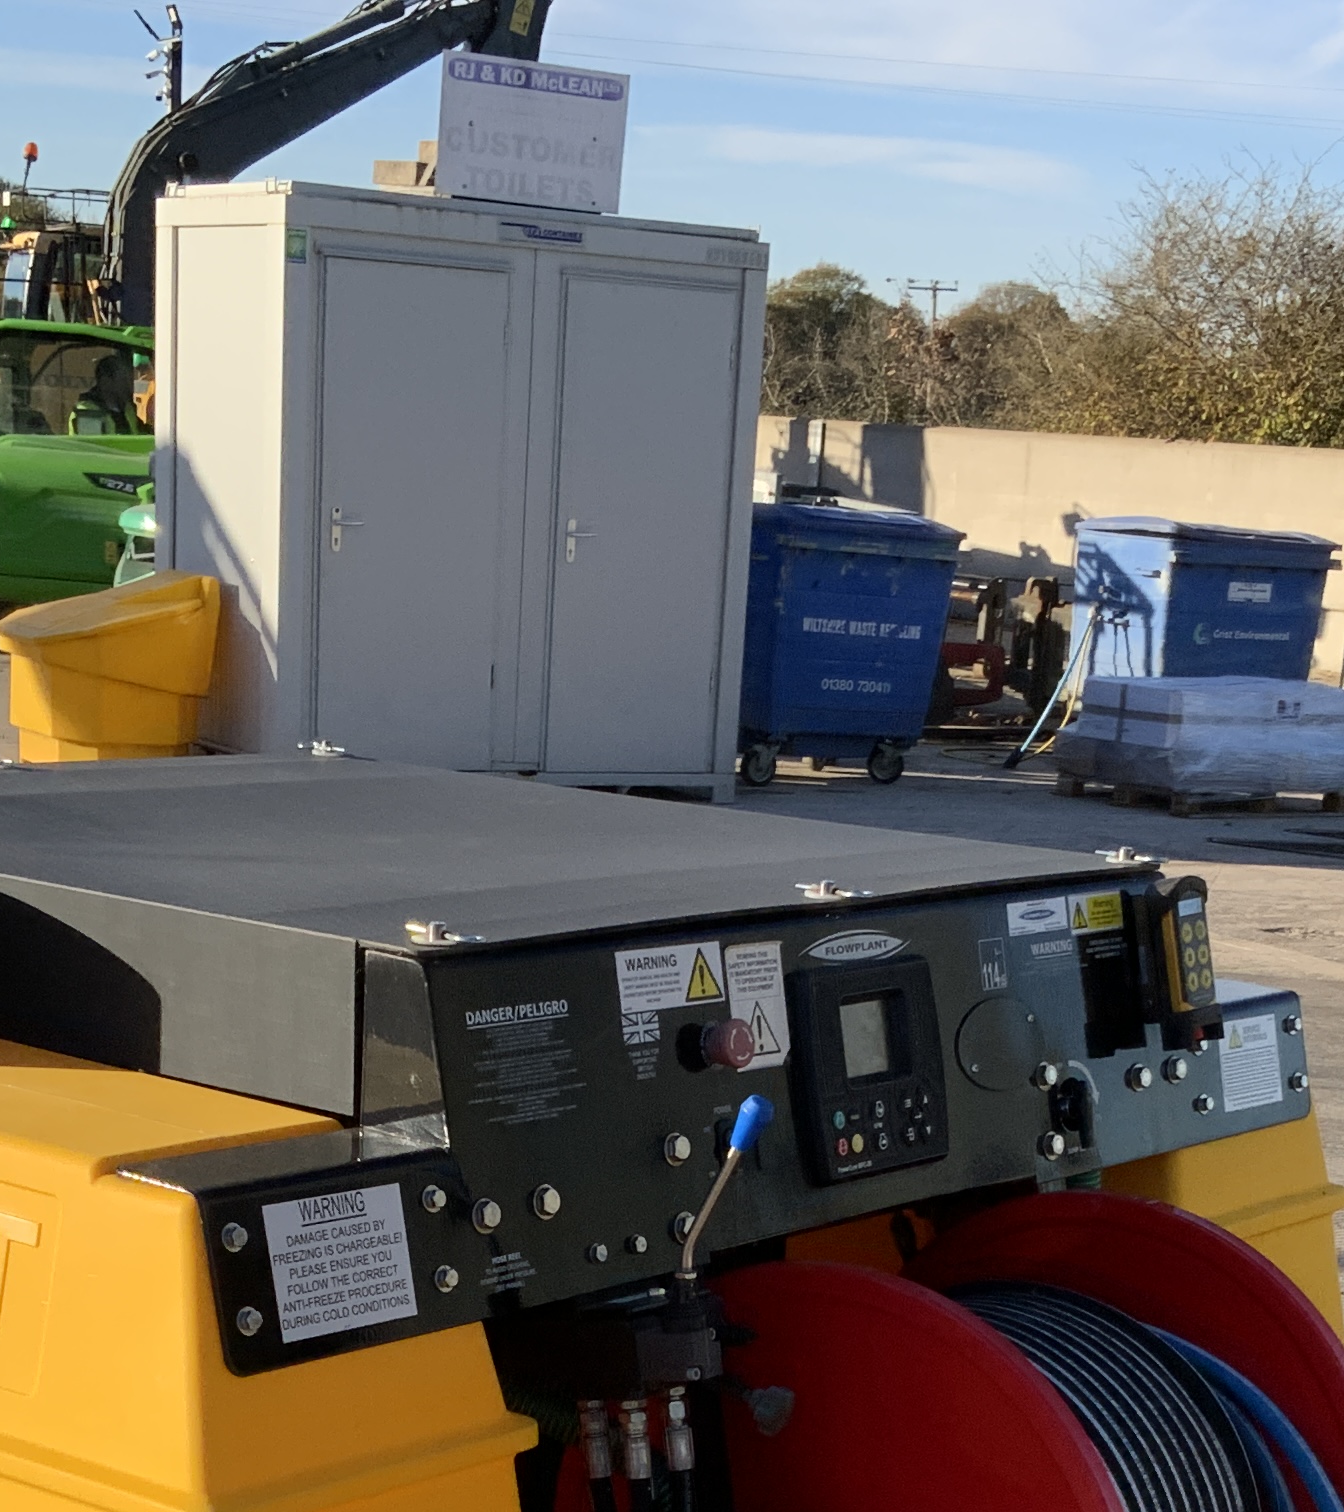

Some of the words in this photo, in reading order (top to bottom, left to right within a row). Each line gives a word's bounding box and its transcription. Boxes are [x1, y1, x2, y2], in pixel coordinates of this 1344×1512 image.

[455, 61, 475, 79] RJ
[480, 64, 496, 83] &
[499, 67, 527, 87] KD
[530, 72, 604, 98] McLEAN
[445, 124, 617, 173] CUSTOMER
[465, 163, 595, 203] TOILETS
[802, 617, 847, 634] WILTSHIRE
[848, 620, 877, 637] WASTE
[820, 678, 854, 692] 01380
[824, 939, 889, 956] FLOWPLANT
[1029, 938, 1073, 956] WARNING
[624, 953, 678, 972] WARNING
[465, 999, 569, 1026] DANGER/PELIGRO
[298, 1190, 367, 1223] WARNING
[285, 1228, 330, 1248] DAMAGE
[330, 1222, 371, 1240] CAUSED
[373, 1219, 386, 1232] BY
[272, 1245, 324, 1267] FREEZING
[324, 1243, 335, 1257] IS
[335, 1231, 403, 1256] CHARGEABLE!
[289, 1262, 329, 1280] PLEASE
[329, 1255, 371, 1274] ENSURE
[371, 1249, 393, 1265] YOU
[286, 1278, 329, 1297] FOLLOW
[330, 1274, 352, 1289] THE
[352, 1264, 399, 1285] CORRECT
[282, 1290, 347, 1314] ANTI-FREEZE
[347, 1278, 408, 1300] PROCEDURE
[281, 1314, 322, 1332] DURING
[322, 1307, 351, 1323] COLD
